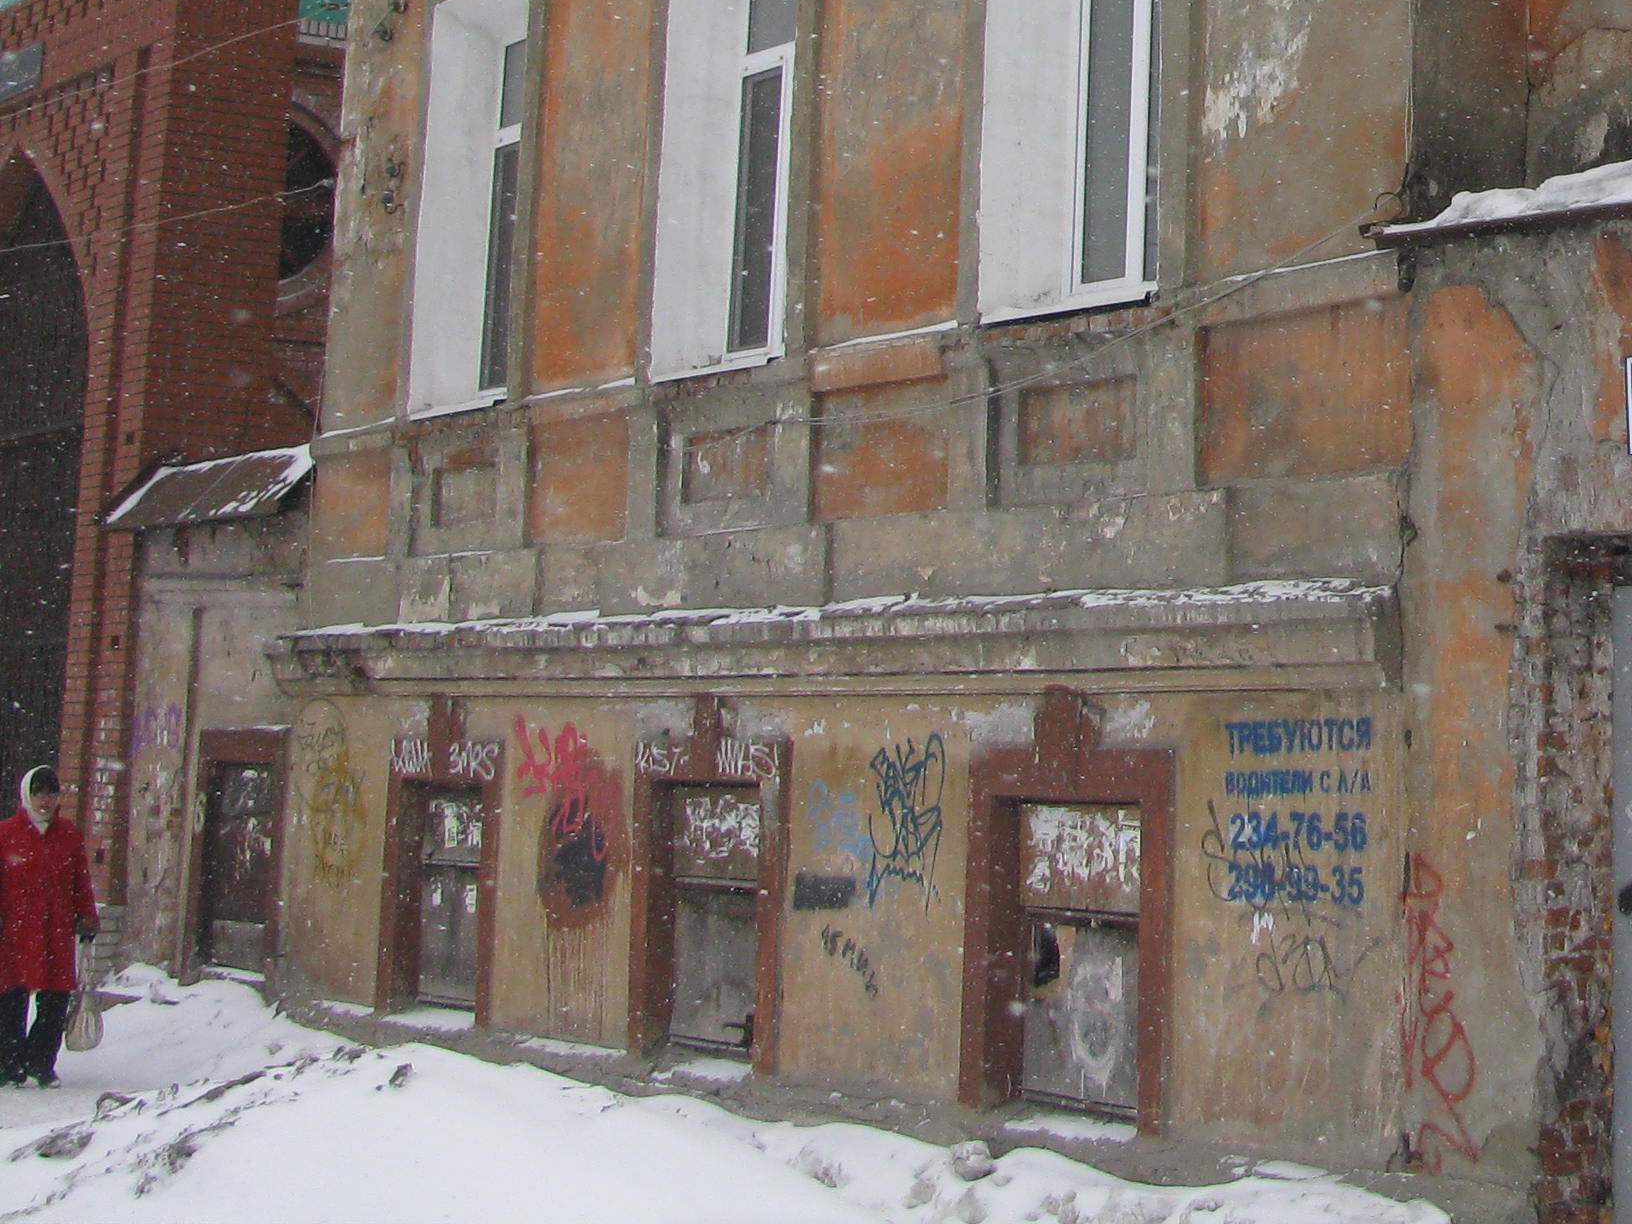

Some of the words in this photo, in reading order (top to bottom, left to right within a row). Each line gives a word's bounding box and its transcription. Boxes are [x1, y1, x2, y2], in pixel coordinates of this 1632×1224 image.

[1225, 717, 1373, 755] ТРЕБУЮТСЯ
[1225, 769, 1314, 796] ВОДИТЕЛИ
[1319, 769, 1331, 793] С
[1230, 811, 1368, 852] 234-76-56
